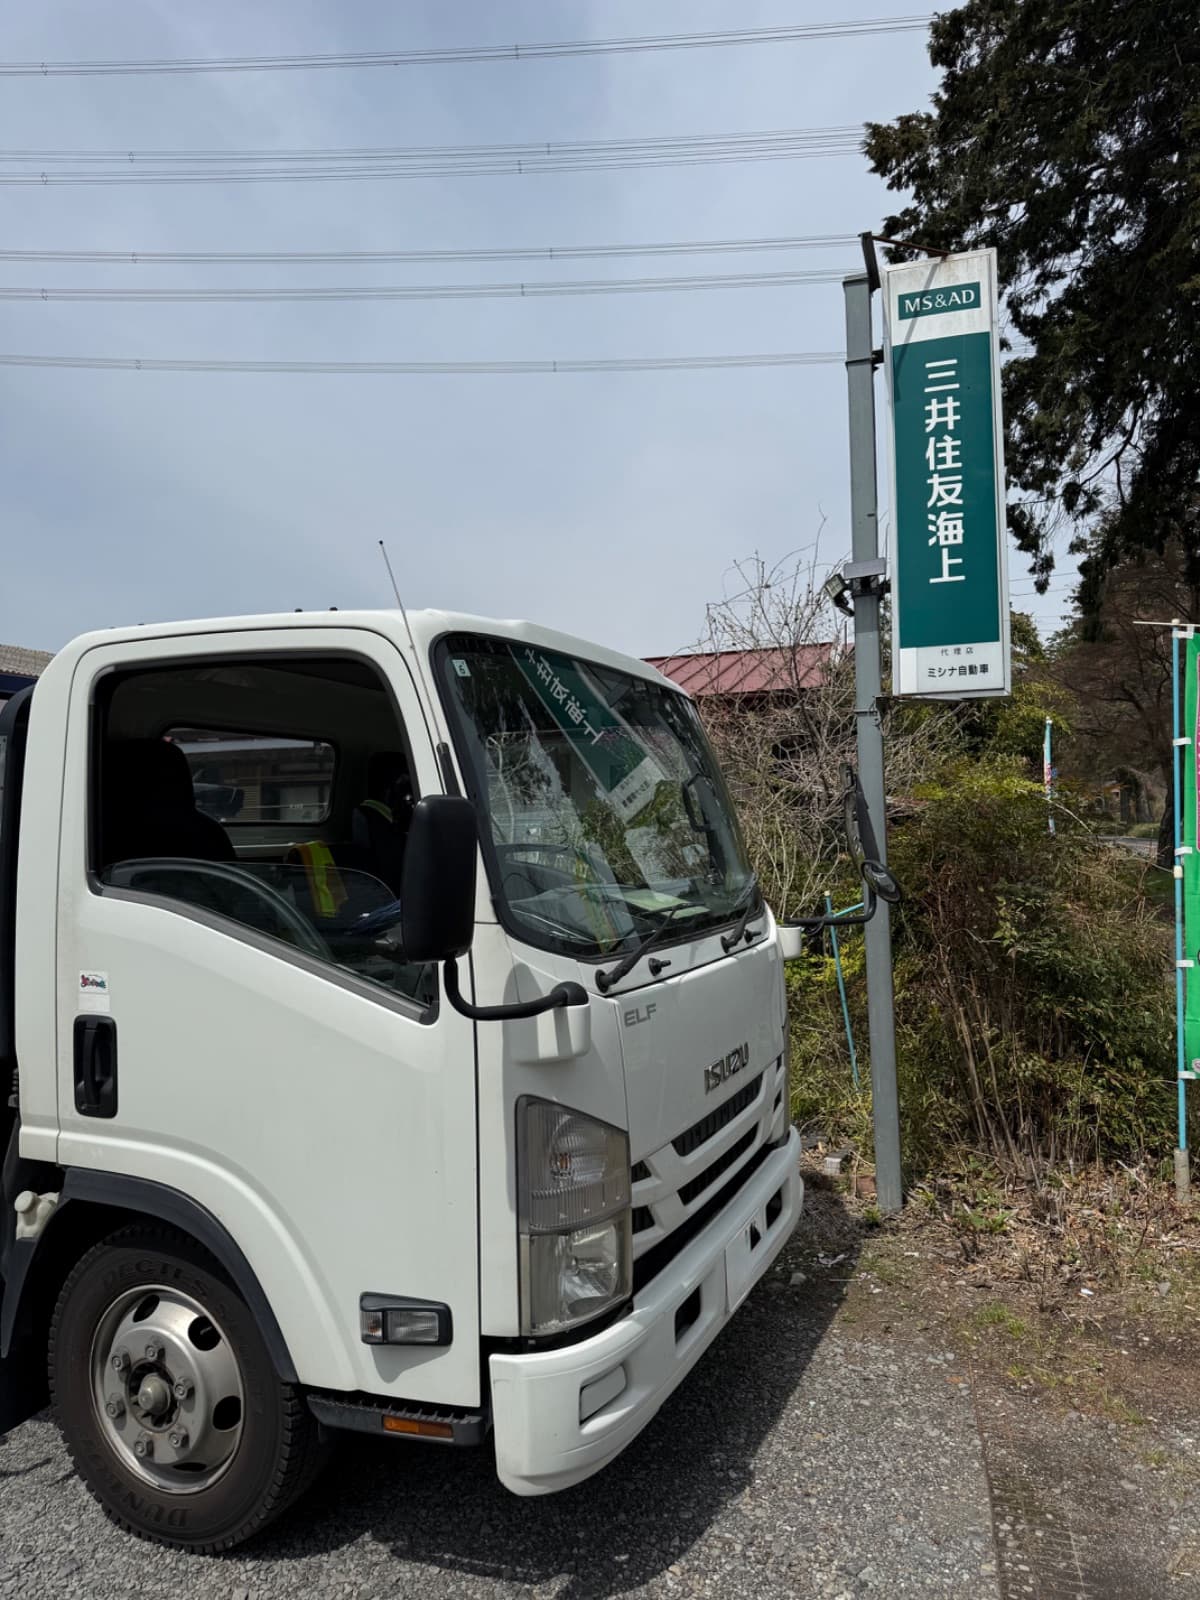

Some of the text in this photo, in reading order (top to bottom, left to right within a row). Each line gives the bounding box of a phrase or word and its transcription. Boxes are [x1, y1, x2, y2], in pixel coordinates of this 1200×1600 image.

[904, 289, 975, 313] MS&AD
[924, 359, 966, 584] 三井住友海上
[940, 646, 974, 657] 代理店
[927, 663, 989, 678] ミシナ自動車
[624, 1003, 657, 1027] ELF
[703, 1041, 750, 1096] ISUZU
